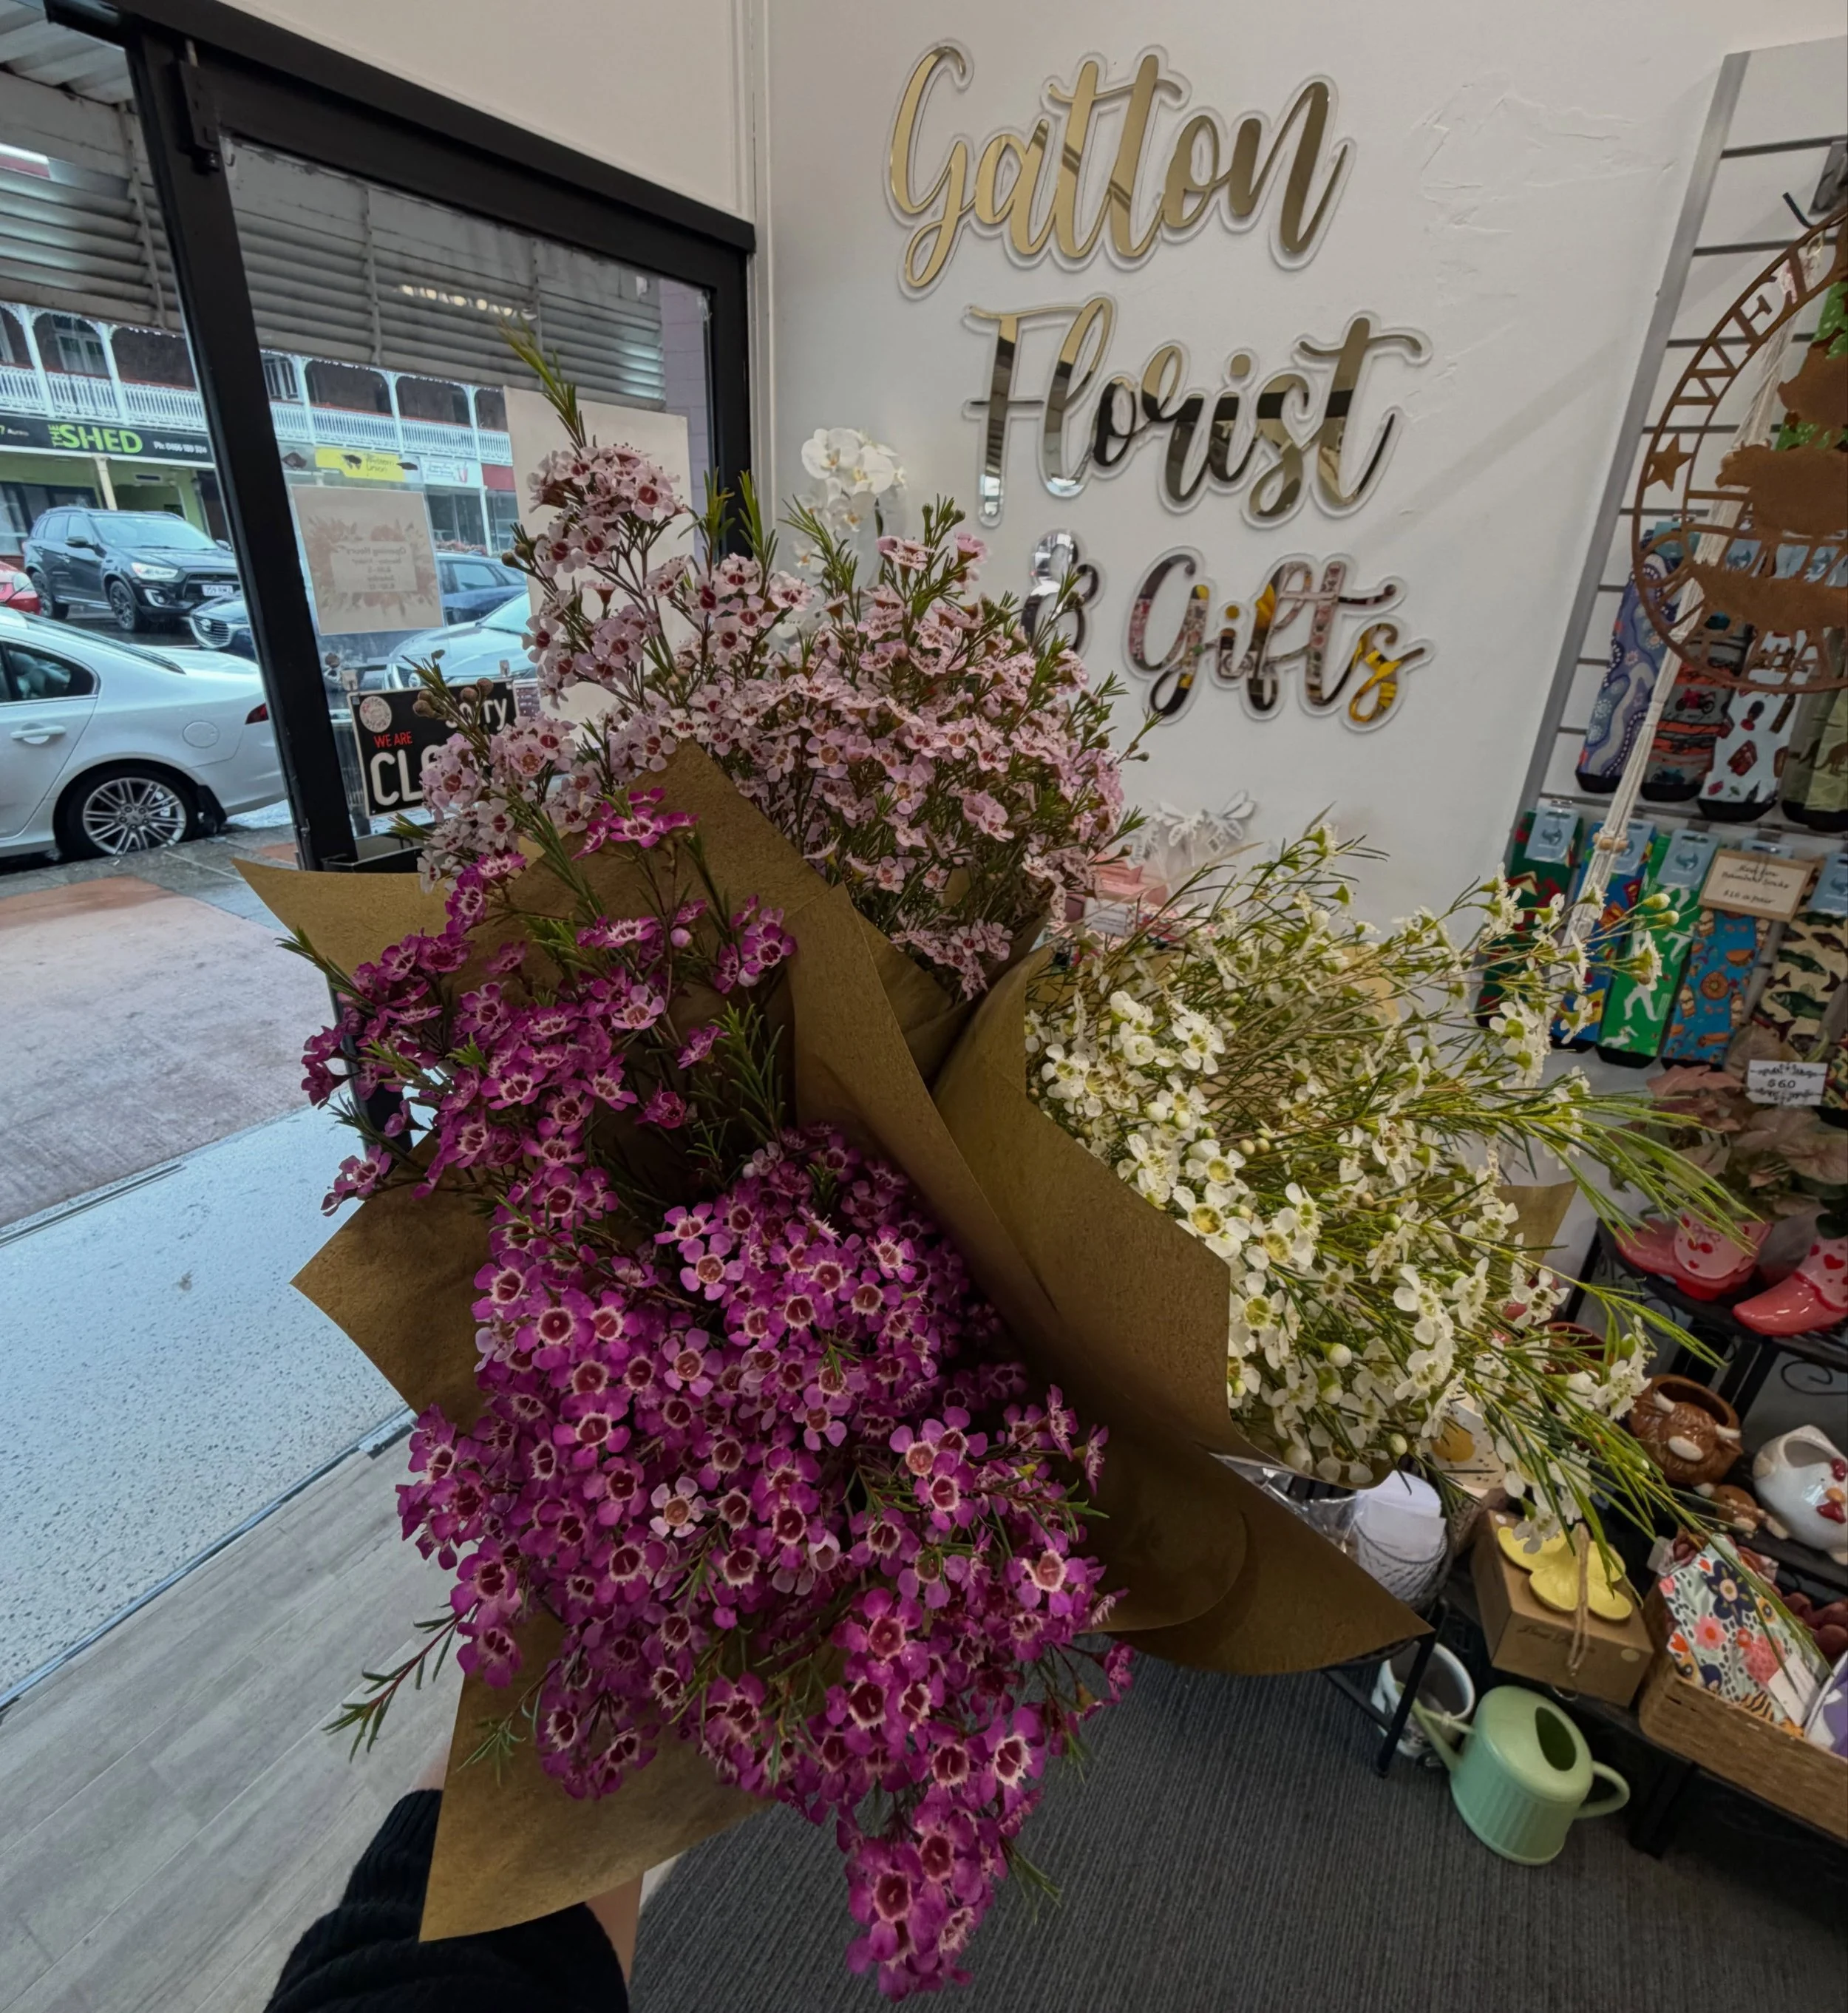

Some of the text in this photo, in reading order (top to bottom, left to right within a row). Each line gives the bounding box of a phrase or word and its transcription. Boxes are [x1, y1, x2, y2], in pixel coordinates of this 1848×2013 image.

[890, 46, 1348, 288] Gatton
[47, 424, 64, 447] THE
[59, 424, 143, 453] SHED
[968, 296, 1423, 519] Florist
[1128, 553, 1426, 723] Gifts
[373, 731, 413, 749] WE ARE
